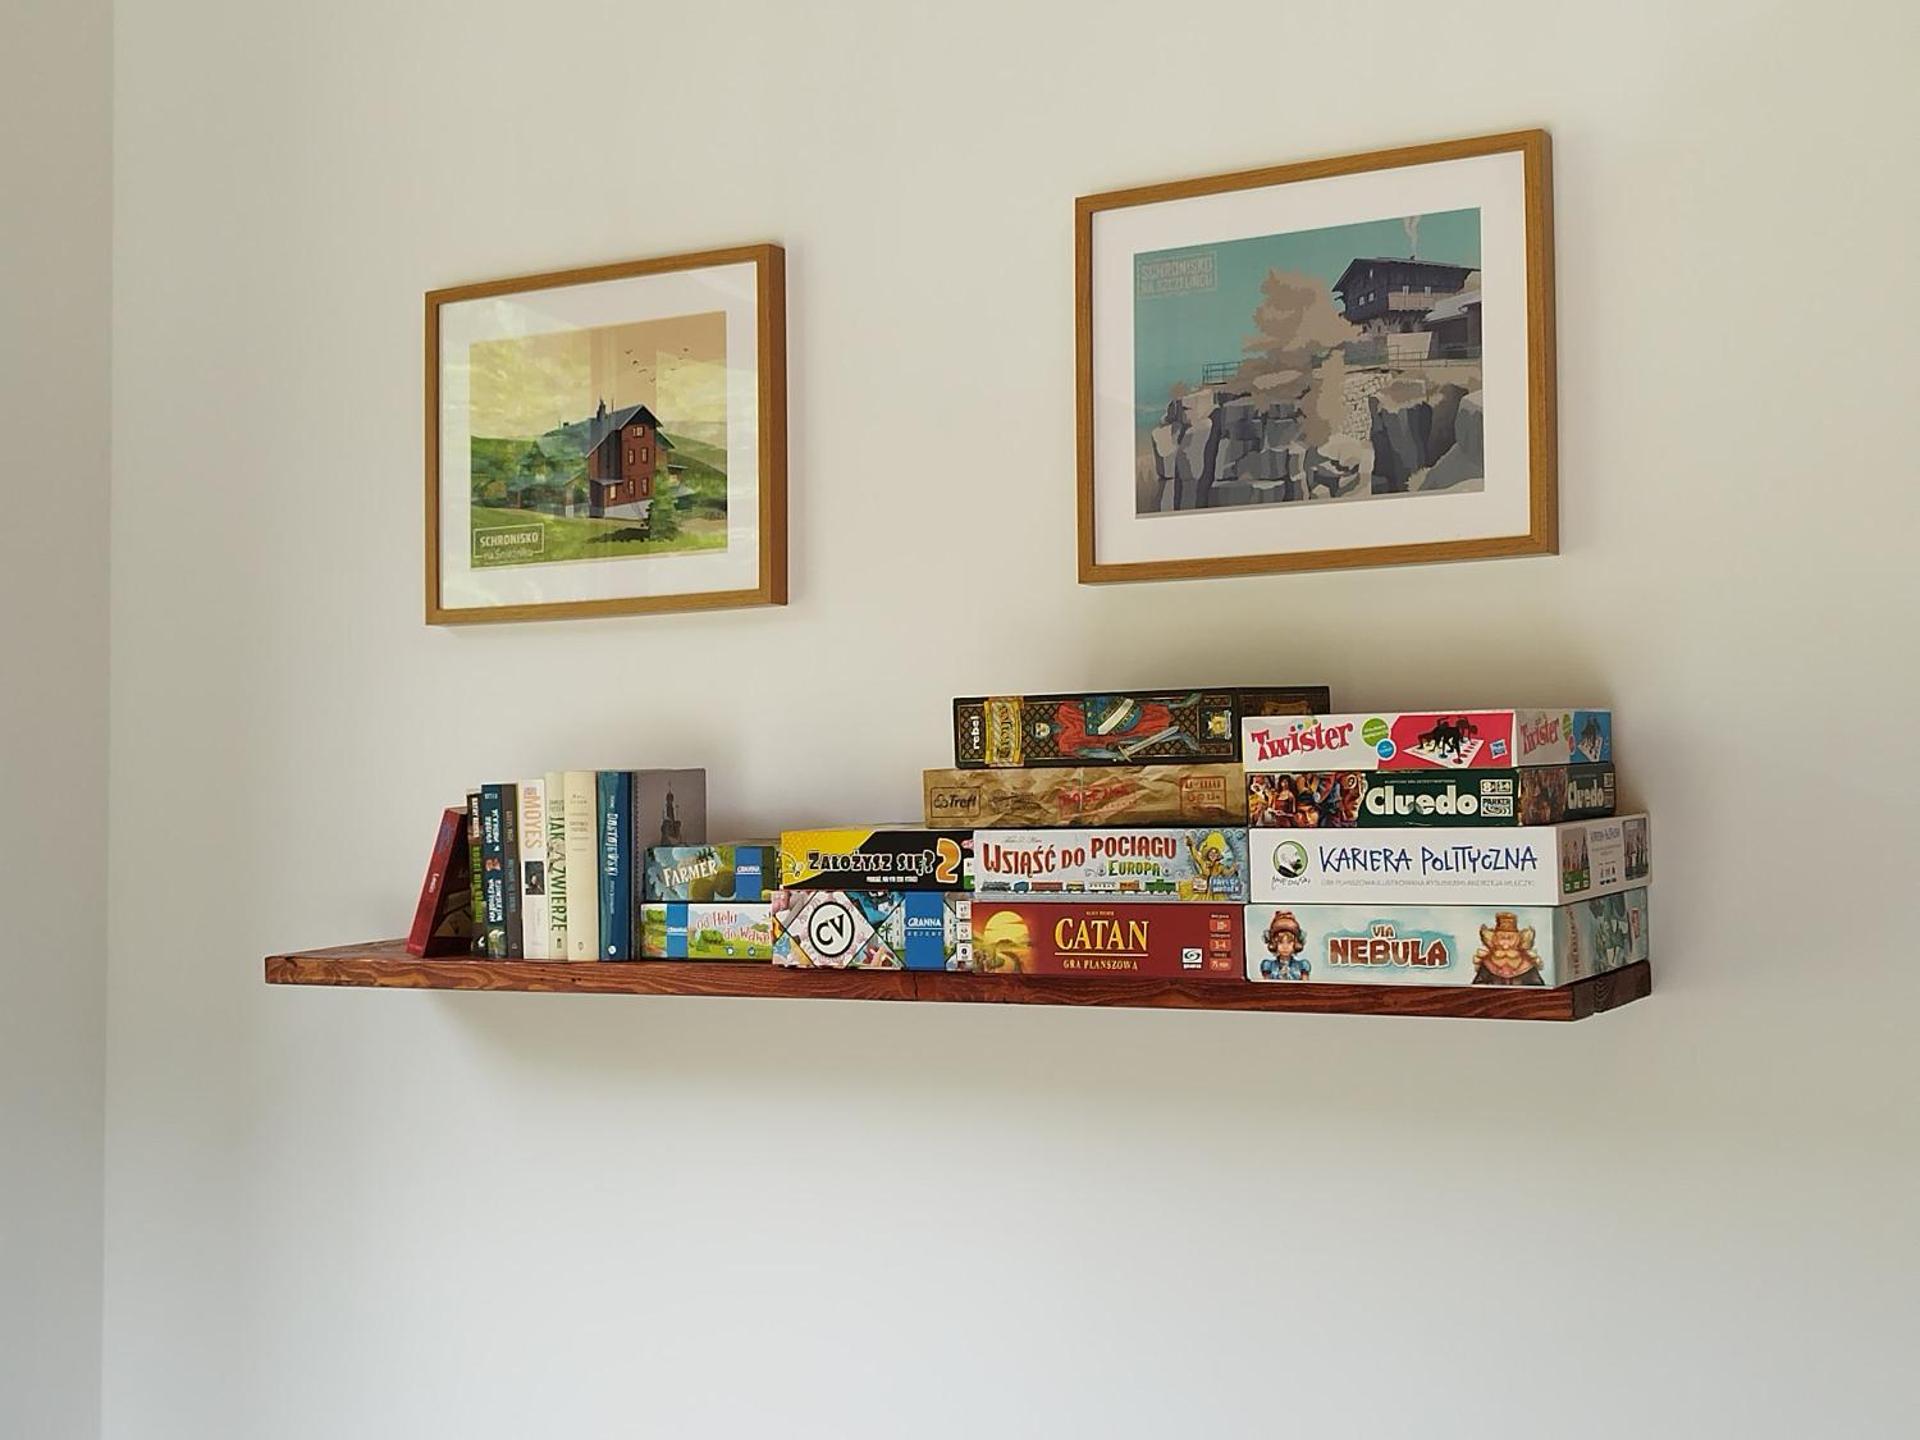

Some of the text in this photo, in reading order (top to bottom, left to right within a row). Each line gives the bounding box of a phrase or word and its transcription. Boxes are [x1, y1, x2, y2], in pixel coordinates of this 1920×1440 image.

[480, 532, 539, 547] SCHRONISKO
[971, 716, 980, 750] rebel
[1251, 722, 1354, 762] Twister
[1520, 716, 1560, 754] Twister
[949, 794, 977, 811] Trefl
[1366, 785, 1479, 815] Cluedo
[1567, 779, 1604, 810] Cluedo
[524, 799, 542, 849] MOYES
[550, 817, 565, 840] JAK
[807, 837, 961, 883] ZAŁOŻYSZ SIĘ? 2
[983, 835, 1177, 878] WSIĄŚĆ DO POCIĄGU
[1108, 860, 1161, 877] EUROPA
[1320, 846, 1538, 876] KARIERA POLITYCZNA
[662, 860, 718, 887] FARMER
[815, 913, 845, 945] CV
[907, 917, 942, 927] GRANNA
[1055, 918, 1149, 951] CATAN
[1373, 925, 1394, 938] VIA
[1063, 960, 1138, 970] GRA PLANSZOWA
[1329, 938, 1449, 966] NEBULA
